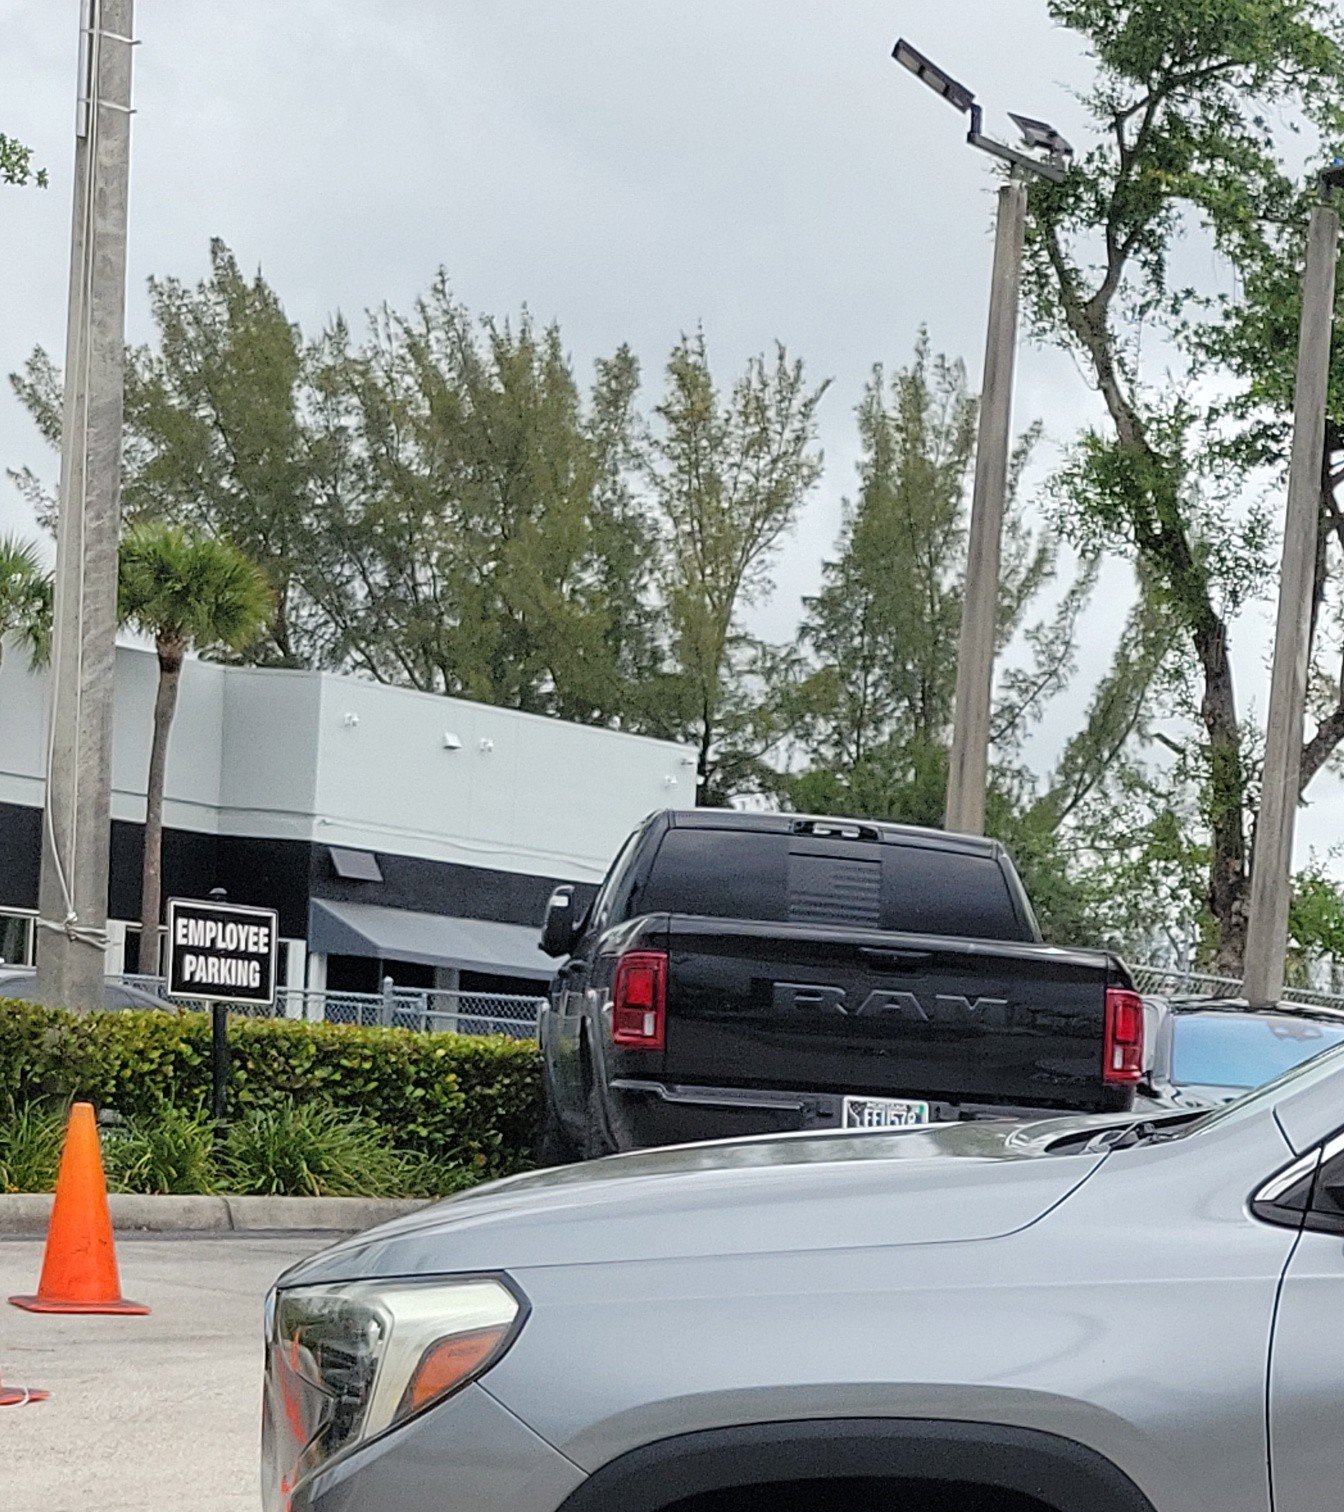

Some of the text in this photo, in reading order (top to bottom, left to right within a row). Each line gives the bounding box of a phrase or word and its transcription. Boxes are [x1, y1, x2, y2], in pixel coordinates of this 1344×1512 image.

[176, 917, 269, 954] EMPLOYEE
[183, 953, 260, 988] PARKING
[772, 981, 1009, 1024] RAM
